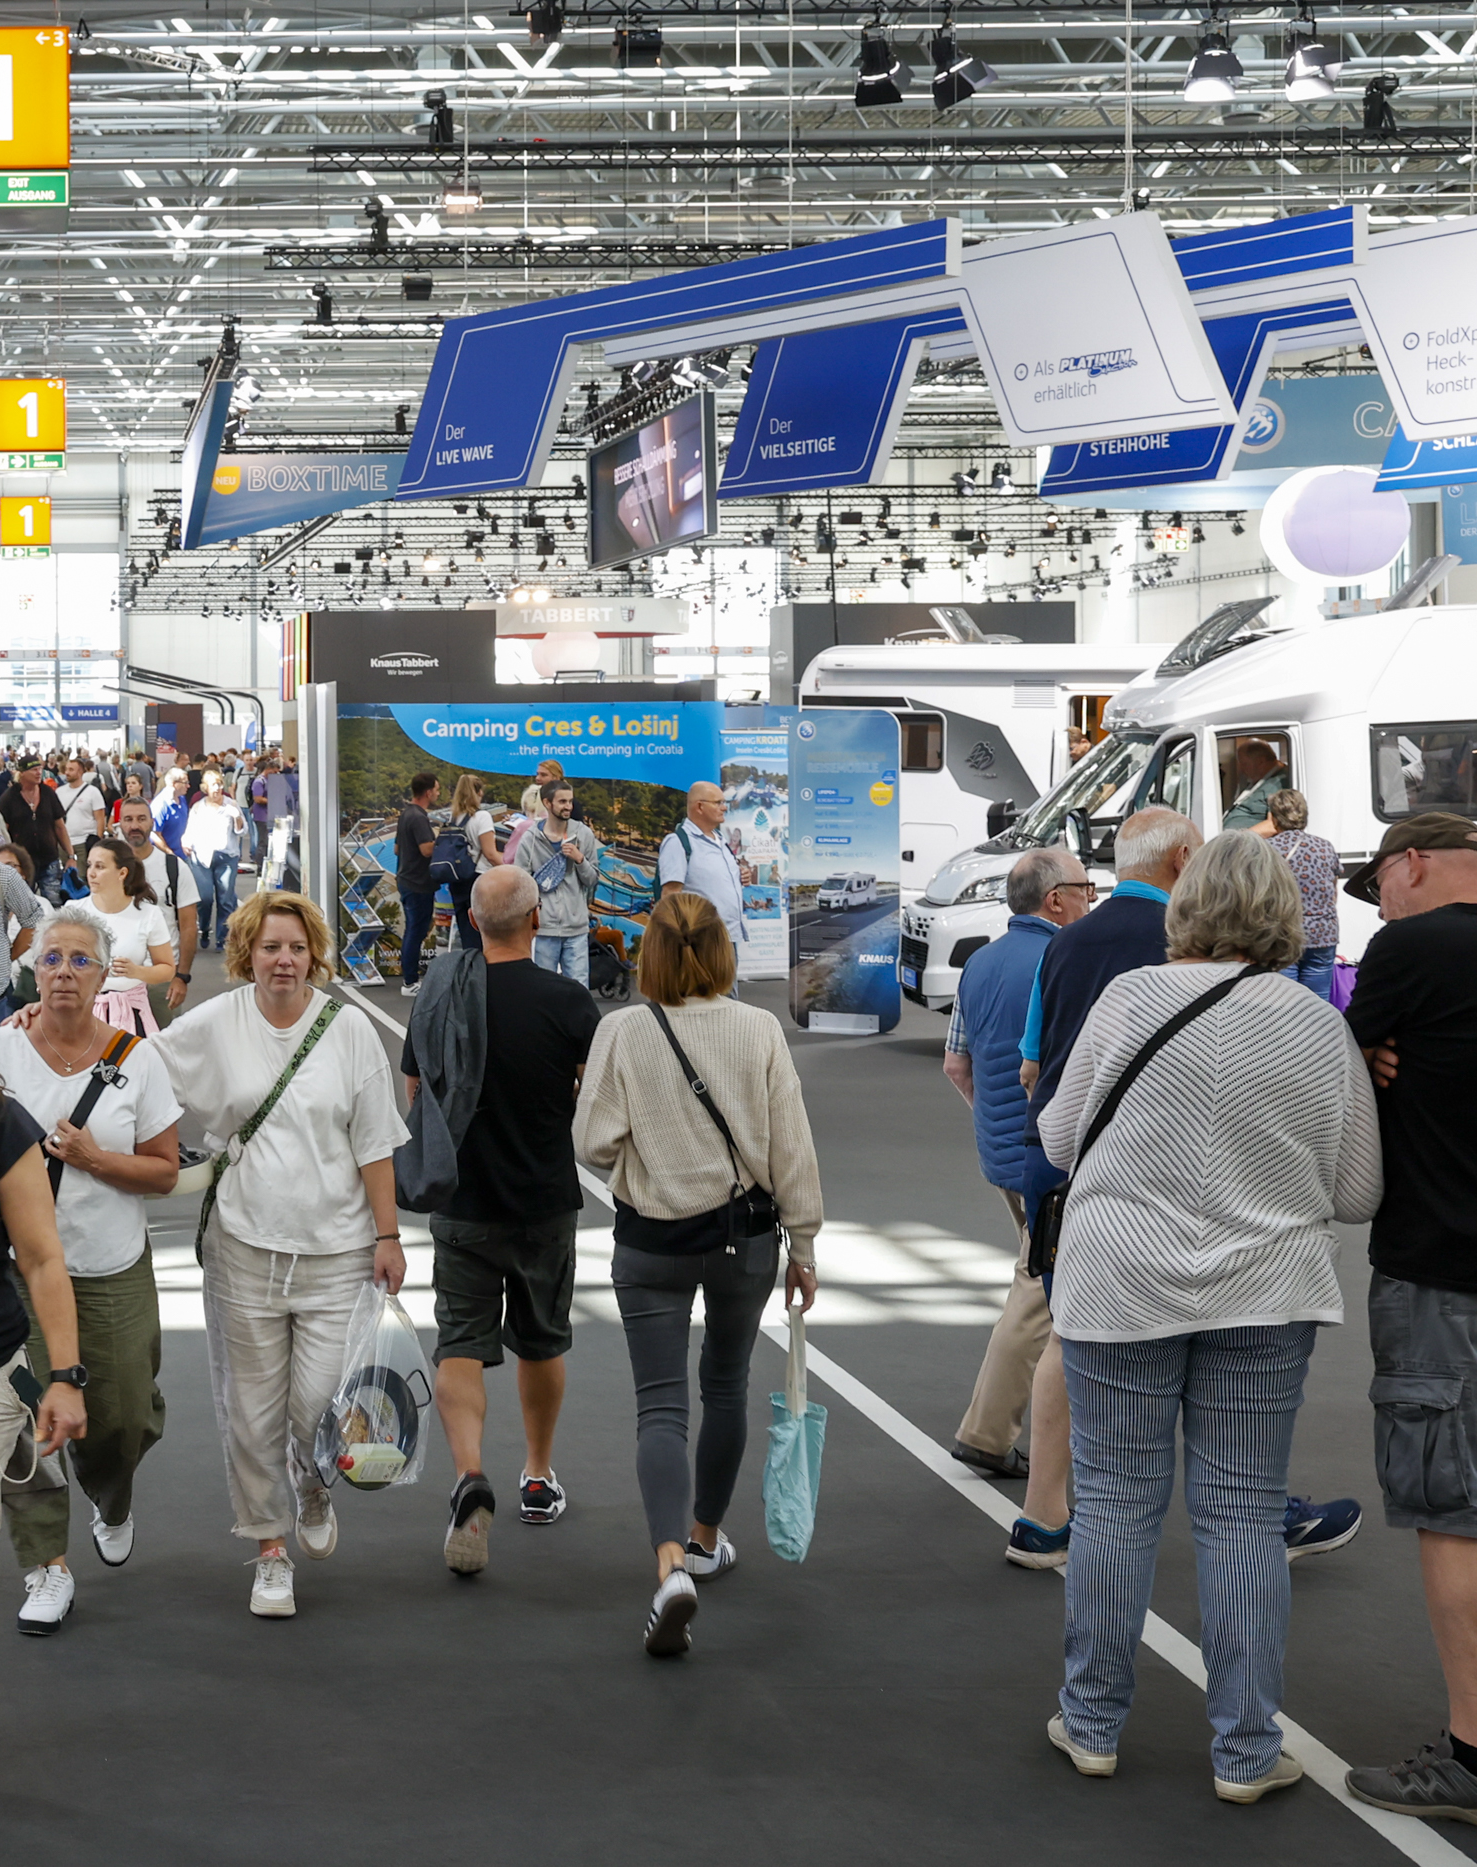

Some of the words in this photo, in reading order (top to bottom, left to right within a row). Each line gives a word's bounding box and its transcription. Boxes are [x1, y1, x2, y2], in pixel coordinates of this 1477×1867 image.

[53, 30, 65, 47] 3
[7, 176, 31, 189] EXIT
[7, 189, 57, 202] AUSGANG
[1034, 359, 1055, 377] Als
[1058, 347, 1133, 374] PLATINUM
[1426, 350, 1474, 371] Heck-
[1033, 379, 1097, 403] erhältlich
[16, 391, 39, 439] 1
[445, 423, 466, 441] Der
[769, 417, 793, 435] Der
[461, 444, 495, 462] WAVE
[759, 436, 837, 460] VIELSEITIGE
[215, 475, 237, 486] NEU
[247, 464, 389, 492] BOXTIME
[18, 504, 34, 538] 1
[1460, 502, 1477, 526] L
[519, 607, 614, 624] TABBERT
[370, 657, 439, 668] KnausTabbert
[398, 668, 423, 677] bewegen
[78, 709, 104, 717] HALLE
[105, 709, 111, 717] 4
[422, 718, 519, 741] Camping
[525, 715, 582, 736] Cres
[588, 714, 606, 736] &
[612, 713, 679, 741] Lošinj
[724, 736, 756, 745] CAMPING
[542, 743, 576, 756] finest
[577, 743, 632, 760] Camping
[634, 743, 645, 756] in
[646, 743, 684, 756] Croatia
[859, 953, 895, 965] KNAUS
